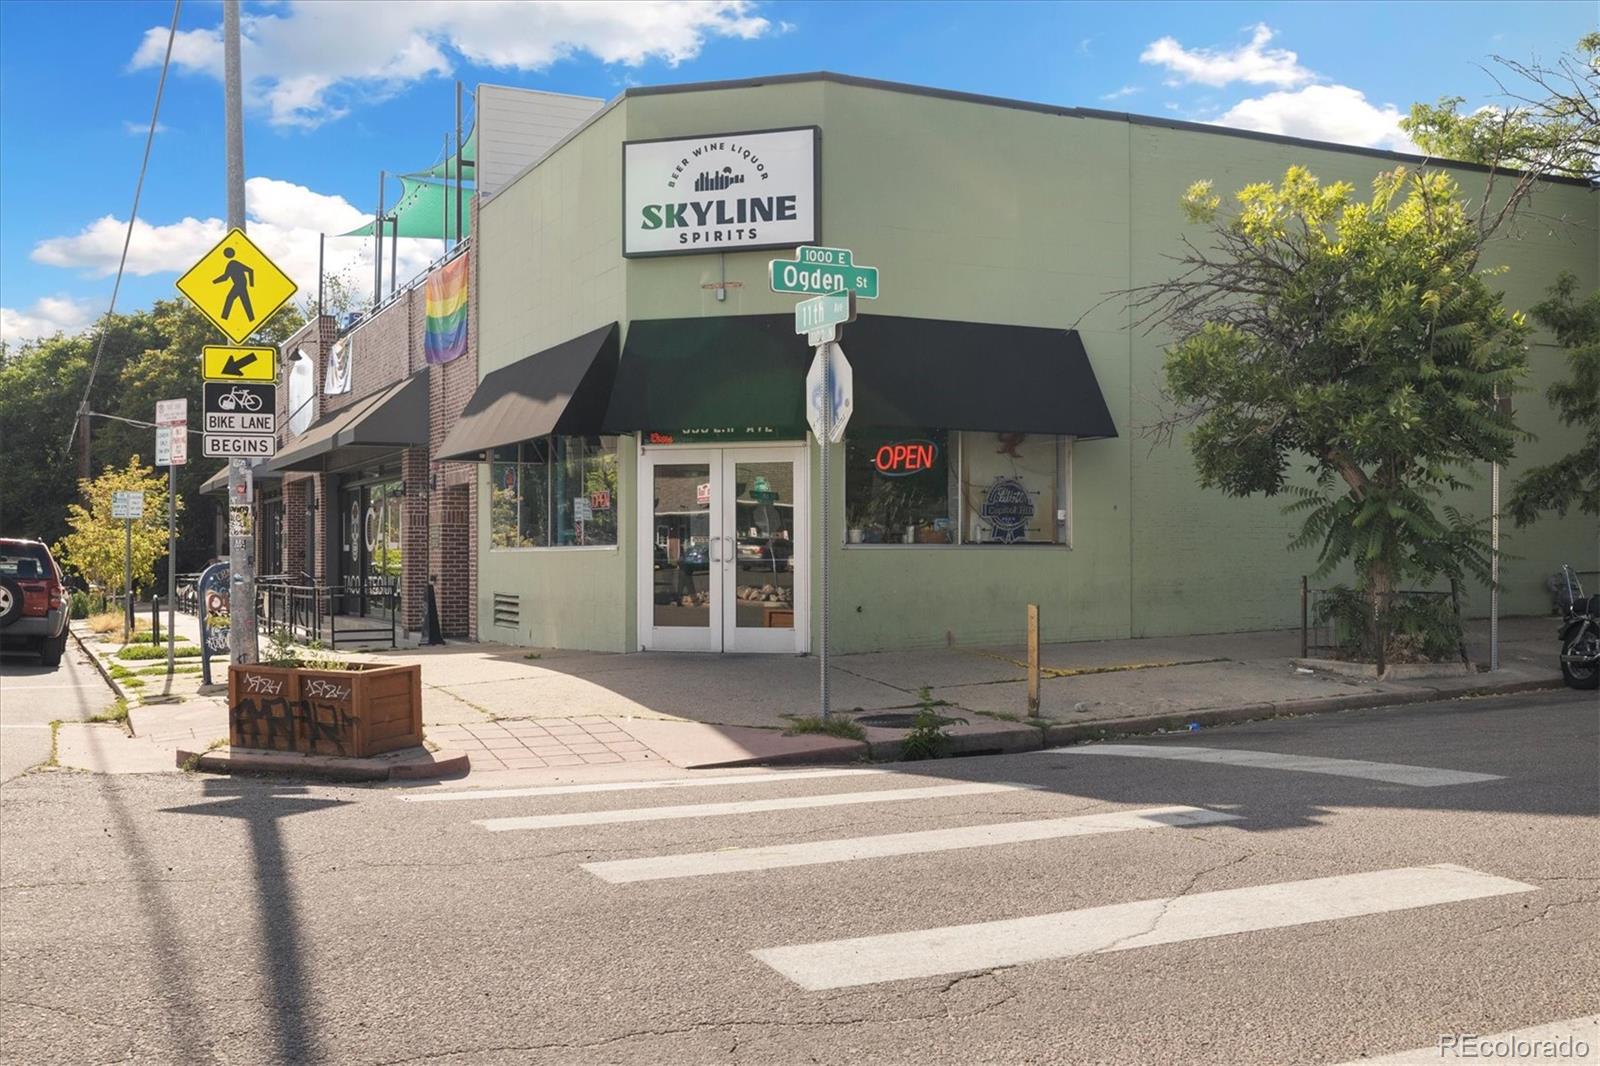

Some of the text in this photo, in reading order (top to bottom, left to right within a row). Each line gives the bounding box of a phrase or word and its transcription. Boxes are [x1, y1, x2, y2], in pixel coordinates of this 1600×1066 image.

[668, 142, 768, 188] BEER WINE LIQUOR
[641, 195, 797, 230] SKYLINE
[680, 228, 757, 244] SPIRITS
[805, 250, 845, 264] 1000 E
[784, 265, 868, 291] Ogden St
[209, 416, 271, 429] BIKE LANE
[211, 440, 268, 453] BEGINS
[876, 445, 933, 470] OPEN
